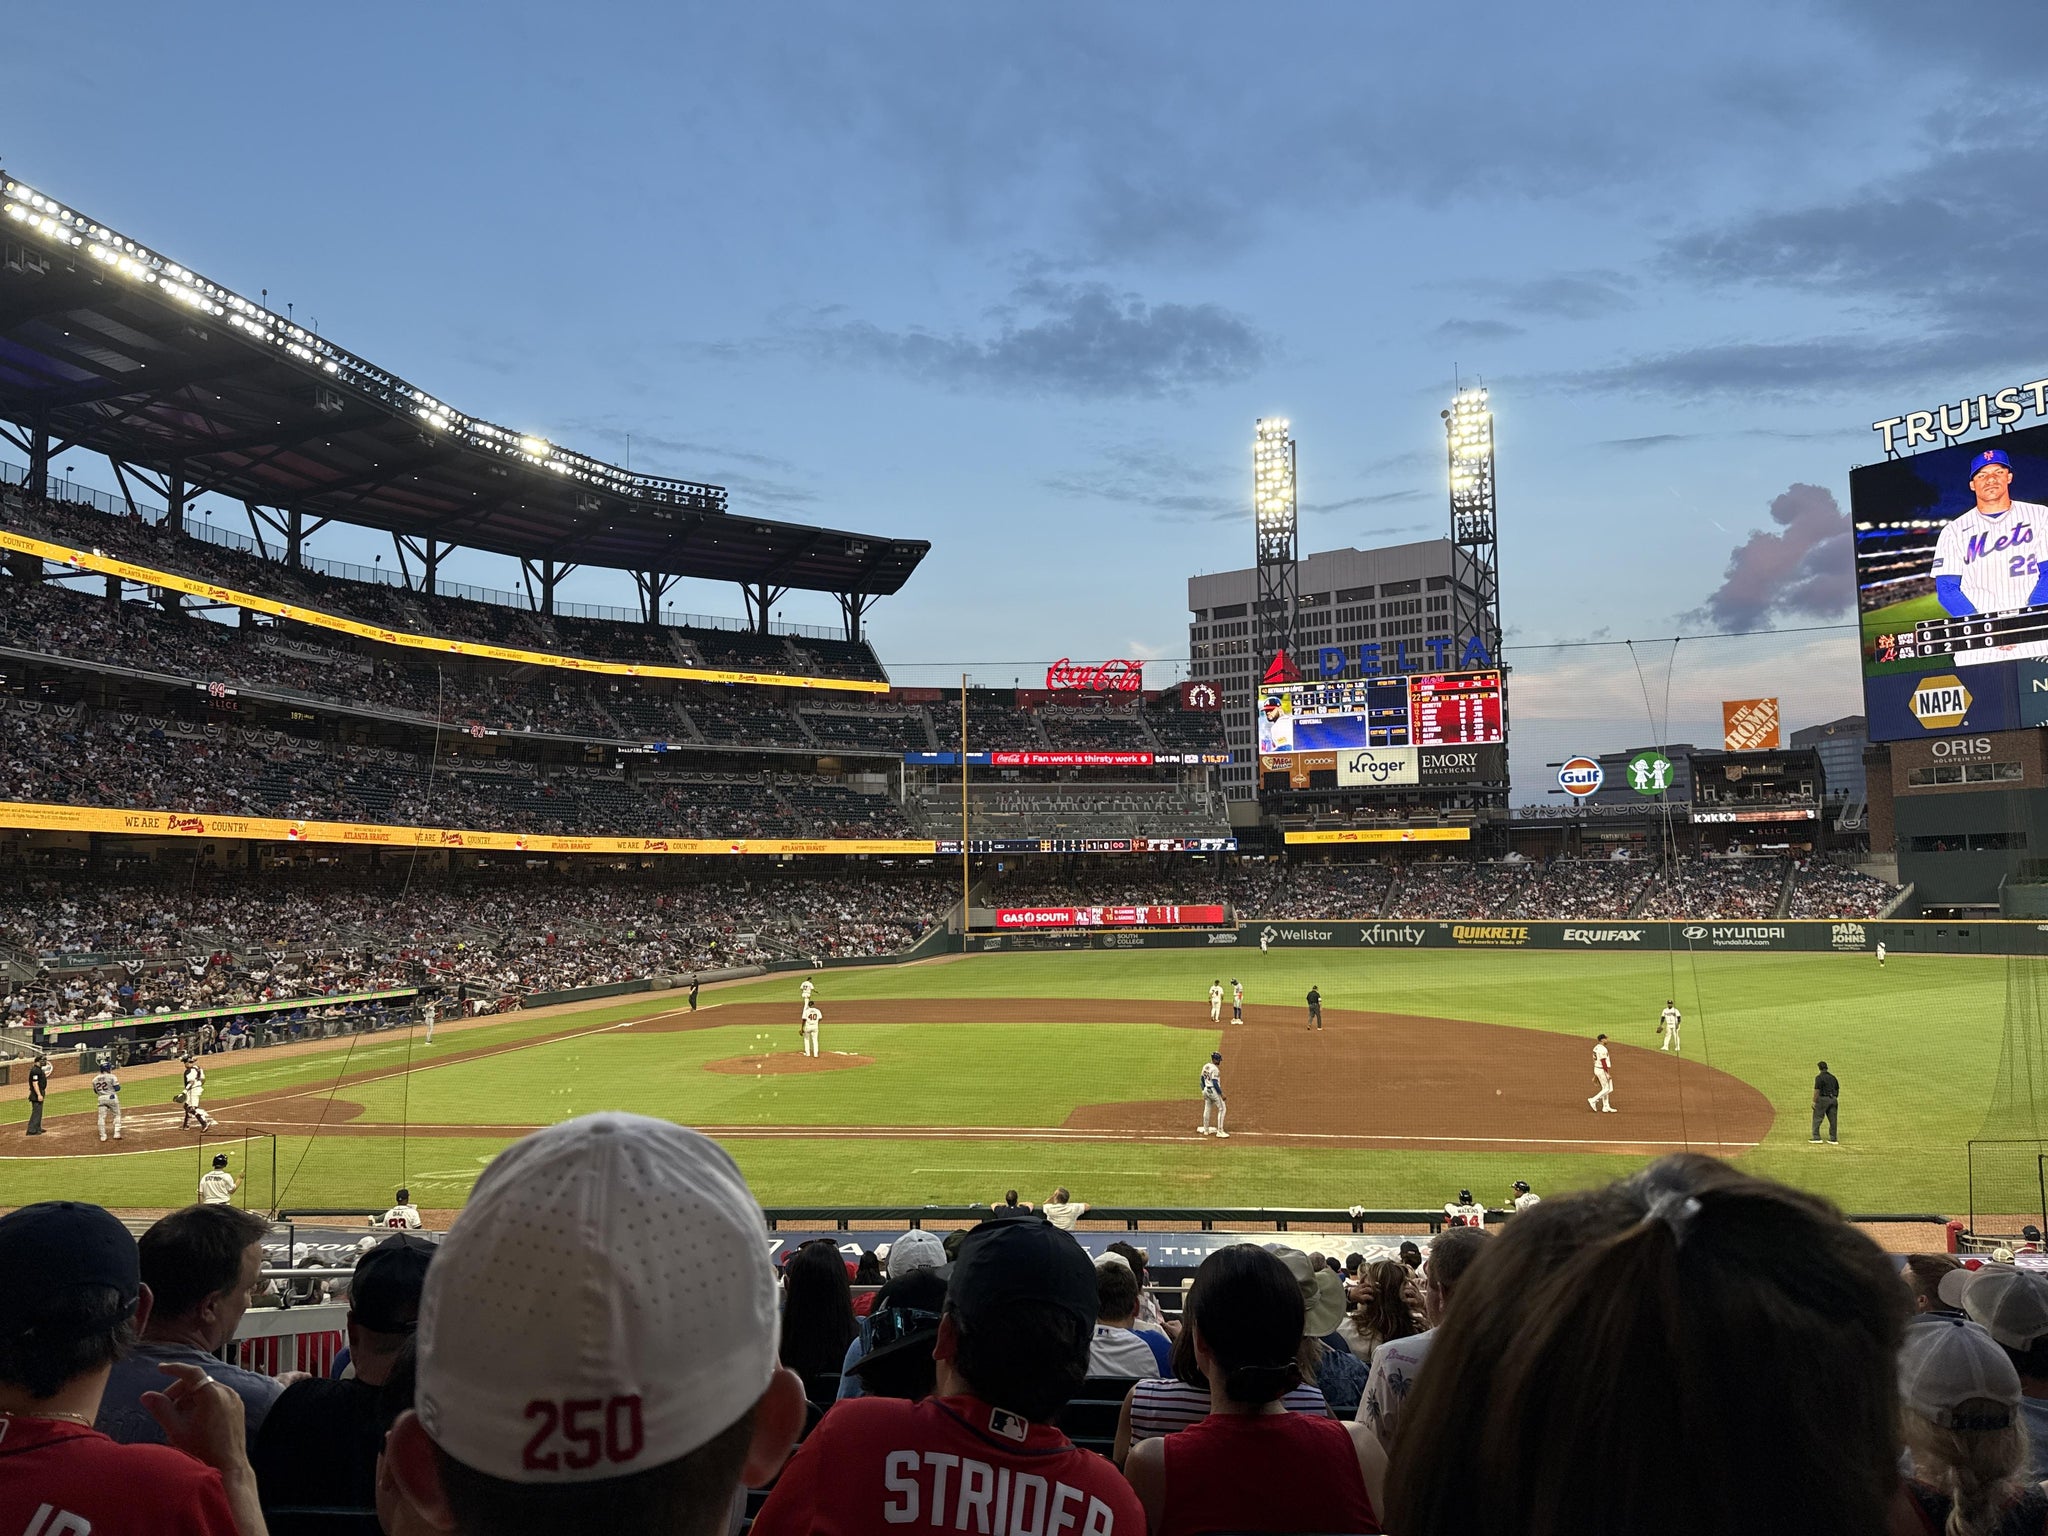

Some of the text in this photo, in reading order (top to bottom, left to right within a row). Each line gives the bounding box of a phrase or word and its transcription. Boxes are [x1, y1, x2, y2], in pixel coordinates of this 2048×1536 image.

[1872, 379, 2048, 452] TRUIST
[2, 536, 35, 550] COUNTRY
[1964, 522, 2034, 565] Mets
[2009, 553, 2039, 578] 22
[183, 582, 256, 606] WE ARE Braves COUNTRY
[1923, 631, 1931, 640] 0
[1944, 628, 1950, 637] 1
[1963, 625, 1971, 635] 0
[1984, 622, 1992, 632] 0
[1924, 645, 1932, 654] 0
[1944, 643, 1952, 651] 2
[1965, 639, 1971, 648] 1
[1985, 636, 1993, 646] 0
[1319, 636, 1492, 676] DELTA
[1046, 657, 1145, 692] Coca-Cola
[208, 681, 225, 697] 44
[209, 699, 238, 710] SLICE
[1411, 694, 1421, 702] 22
[1919, 689, 1963, 714] NAPA
[1729, 705, 1751, 726] THE
[471, 725, 486, 738] 47
[1724, 698, 1778, 750] HOME
[1746, 716, 1779, 749] DEPOT
[1931, 737, 1992, 757] ORIS
[997, 754, 1020, 763] Coca-Cola
[1084, 755, 1114, 764] thirsty
[1421, 753, 1478, 768] EMORY
[1349, 752, 1405, 782] Kroger
[1422, 766, 1476, 775] HEALTHCARE
[1742, 766, 1782, 775] CLUBHOUSE
[1561, 770, 1599, 783] Gulf
[125, 815, 249, 833] WE ARE Braves COUNTRY
[343, 831, 390, 841] ATLANTA BRAVES
[414, 832, 425, 841] WE
[425, 833, 436, 842] ARE
[467, 836, 491, 845] COUNTRY
[1003, 912, 1069, 923] GAS SOUTH
[1076, 912, 1089, 921] AL
[1280, 929, 1333, 940] Wellstar
[1360, 924, 1426, 945] xfinity
[1452, 925, 1529, 939] QUIKRETE
[1712, 927, 1785, 938] HYUNDAI
[1832, 922, 1865, 934] PAPA
[1563, 929, 1642, 944] EQUIFAX
[1831, 935, 1866, 943] JOHNS
[807, 1013, 818, 1021] 40
[95, 1082, 108, 1091] 22
[523, 1393, 645, 1472] 250
[883, 1450, 1114, 1536] STRIDER
